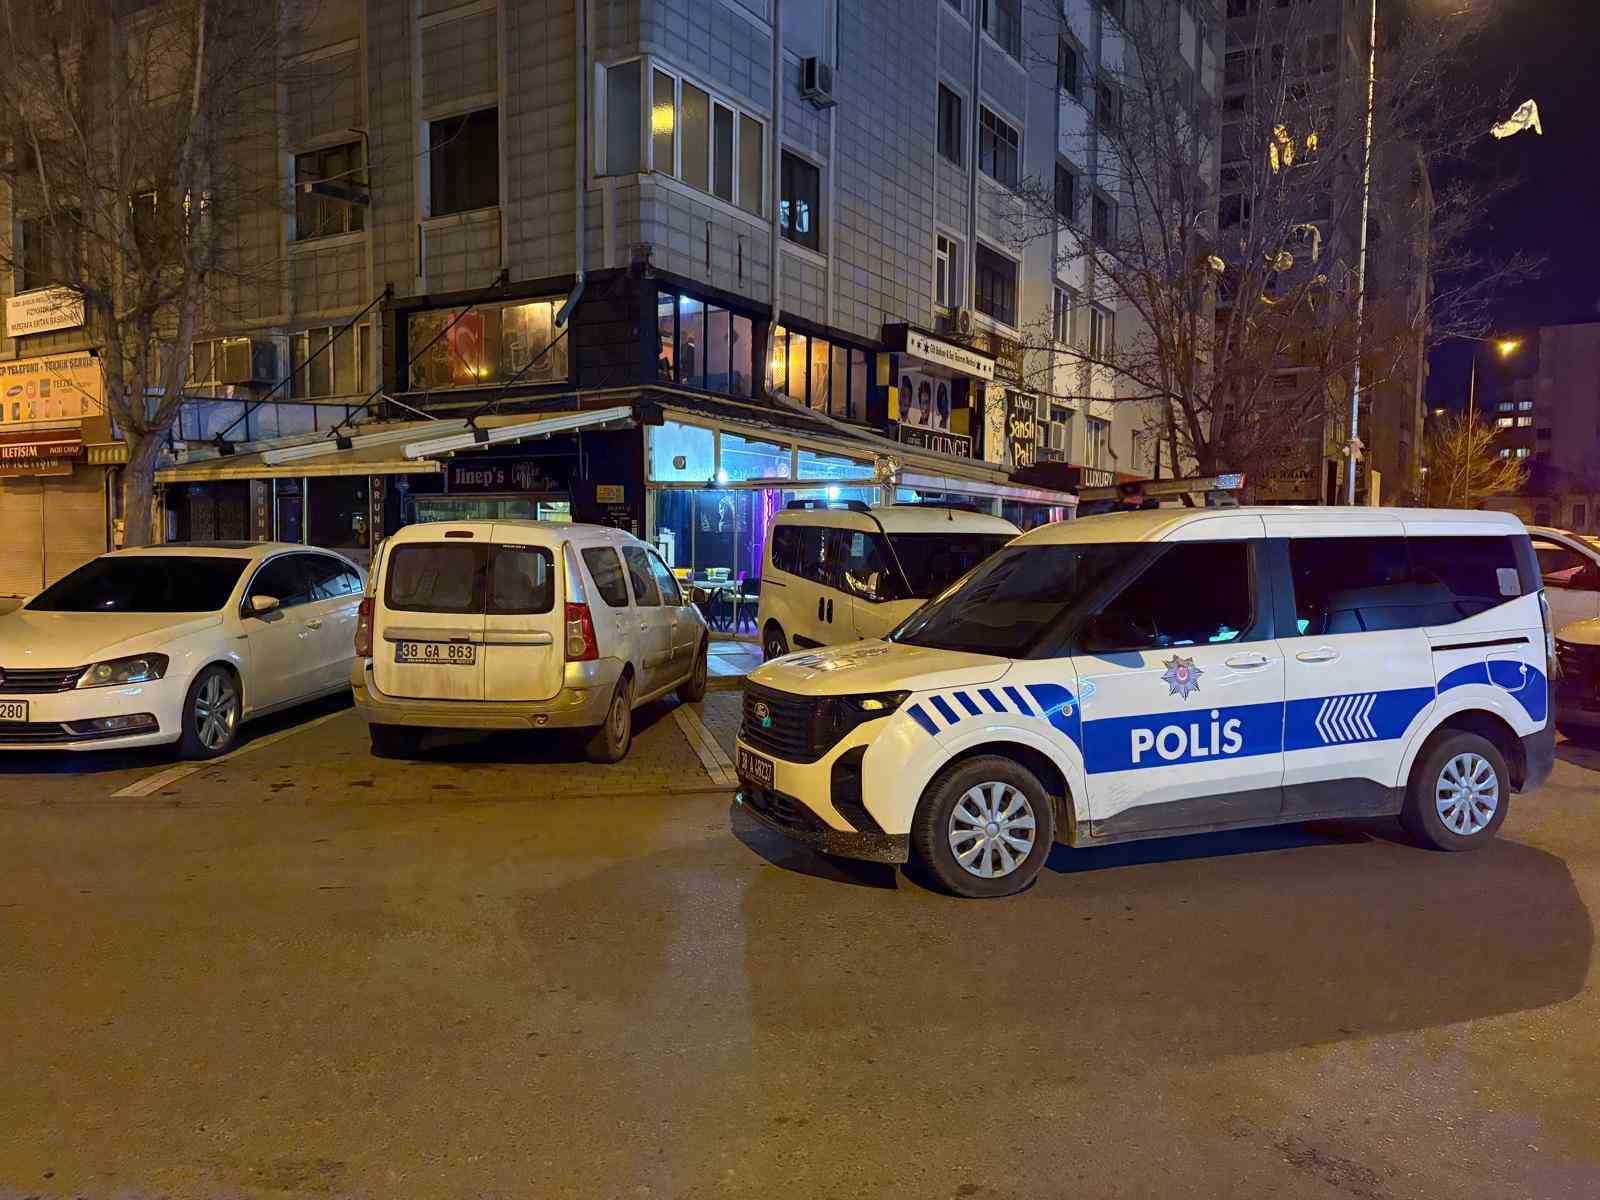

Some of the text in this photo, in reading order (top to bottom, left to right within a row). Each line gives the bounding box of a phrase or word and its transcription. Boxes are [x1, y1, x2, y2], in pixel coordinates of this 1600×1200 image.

[925, 434, 968, 458] LOUNGE
[455, 466, 504, 487] Jinep's
[1085, 469, 1113, 487] LUXURY
[403, 643, 472, 659] 38 GA 863
[0, 704, 22, 718] 280
[1131, 709, 1243, 764] POLİS
